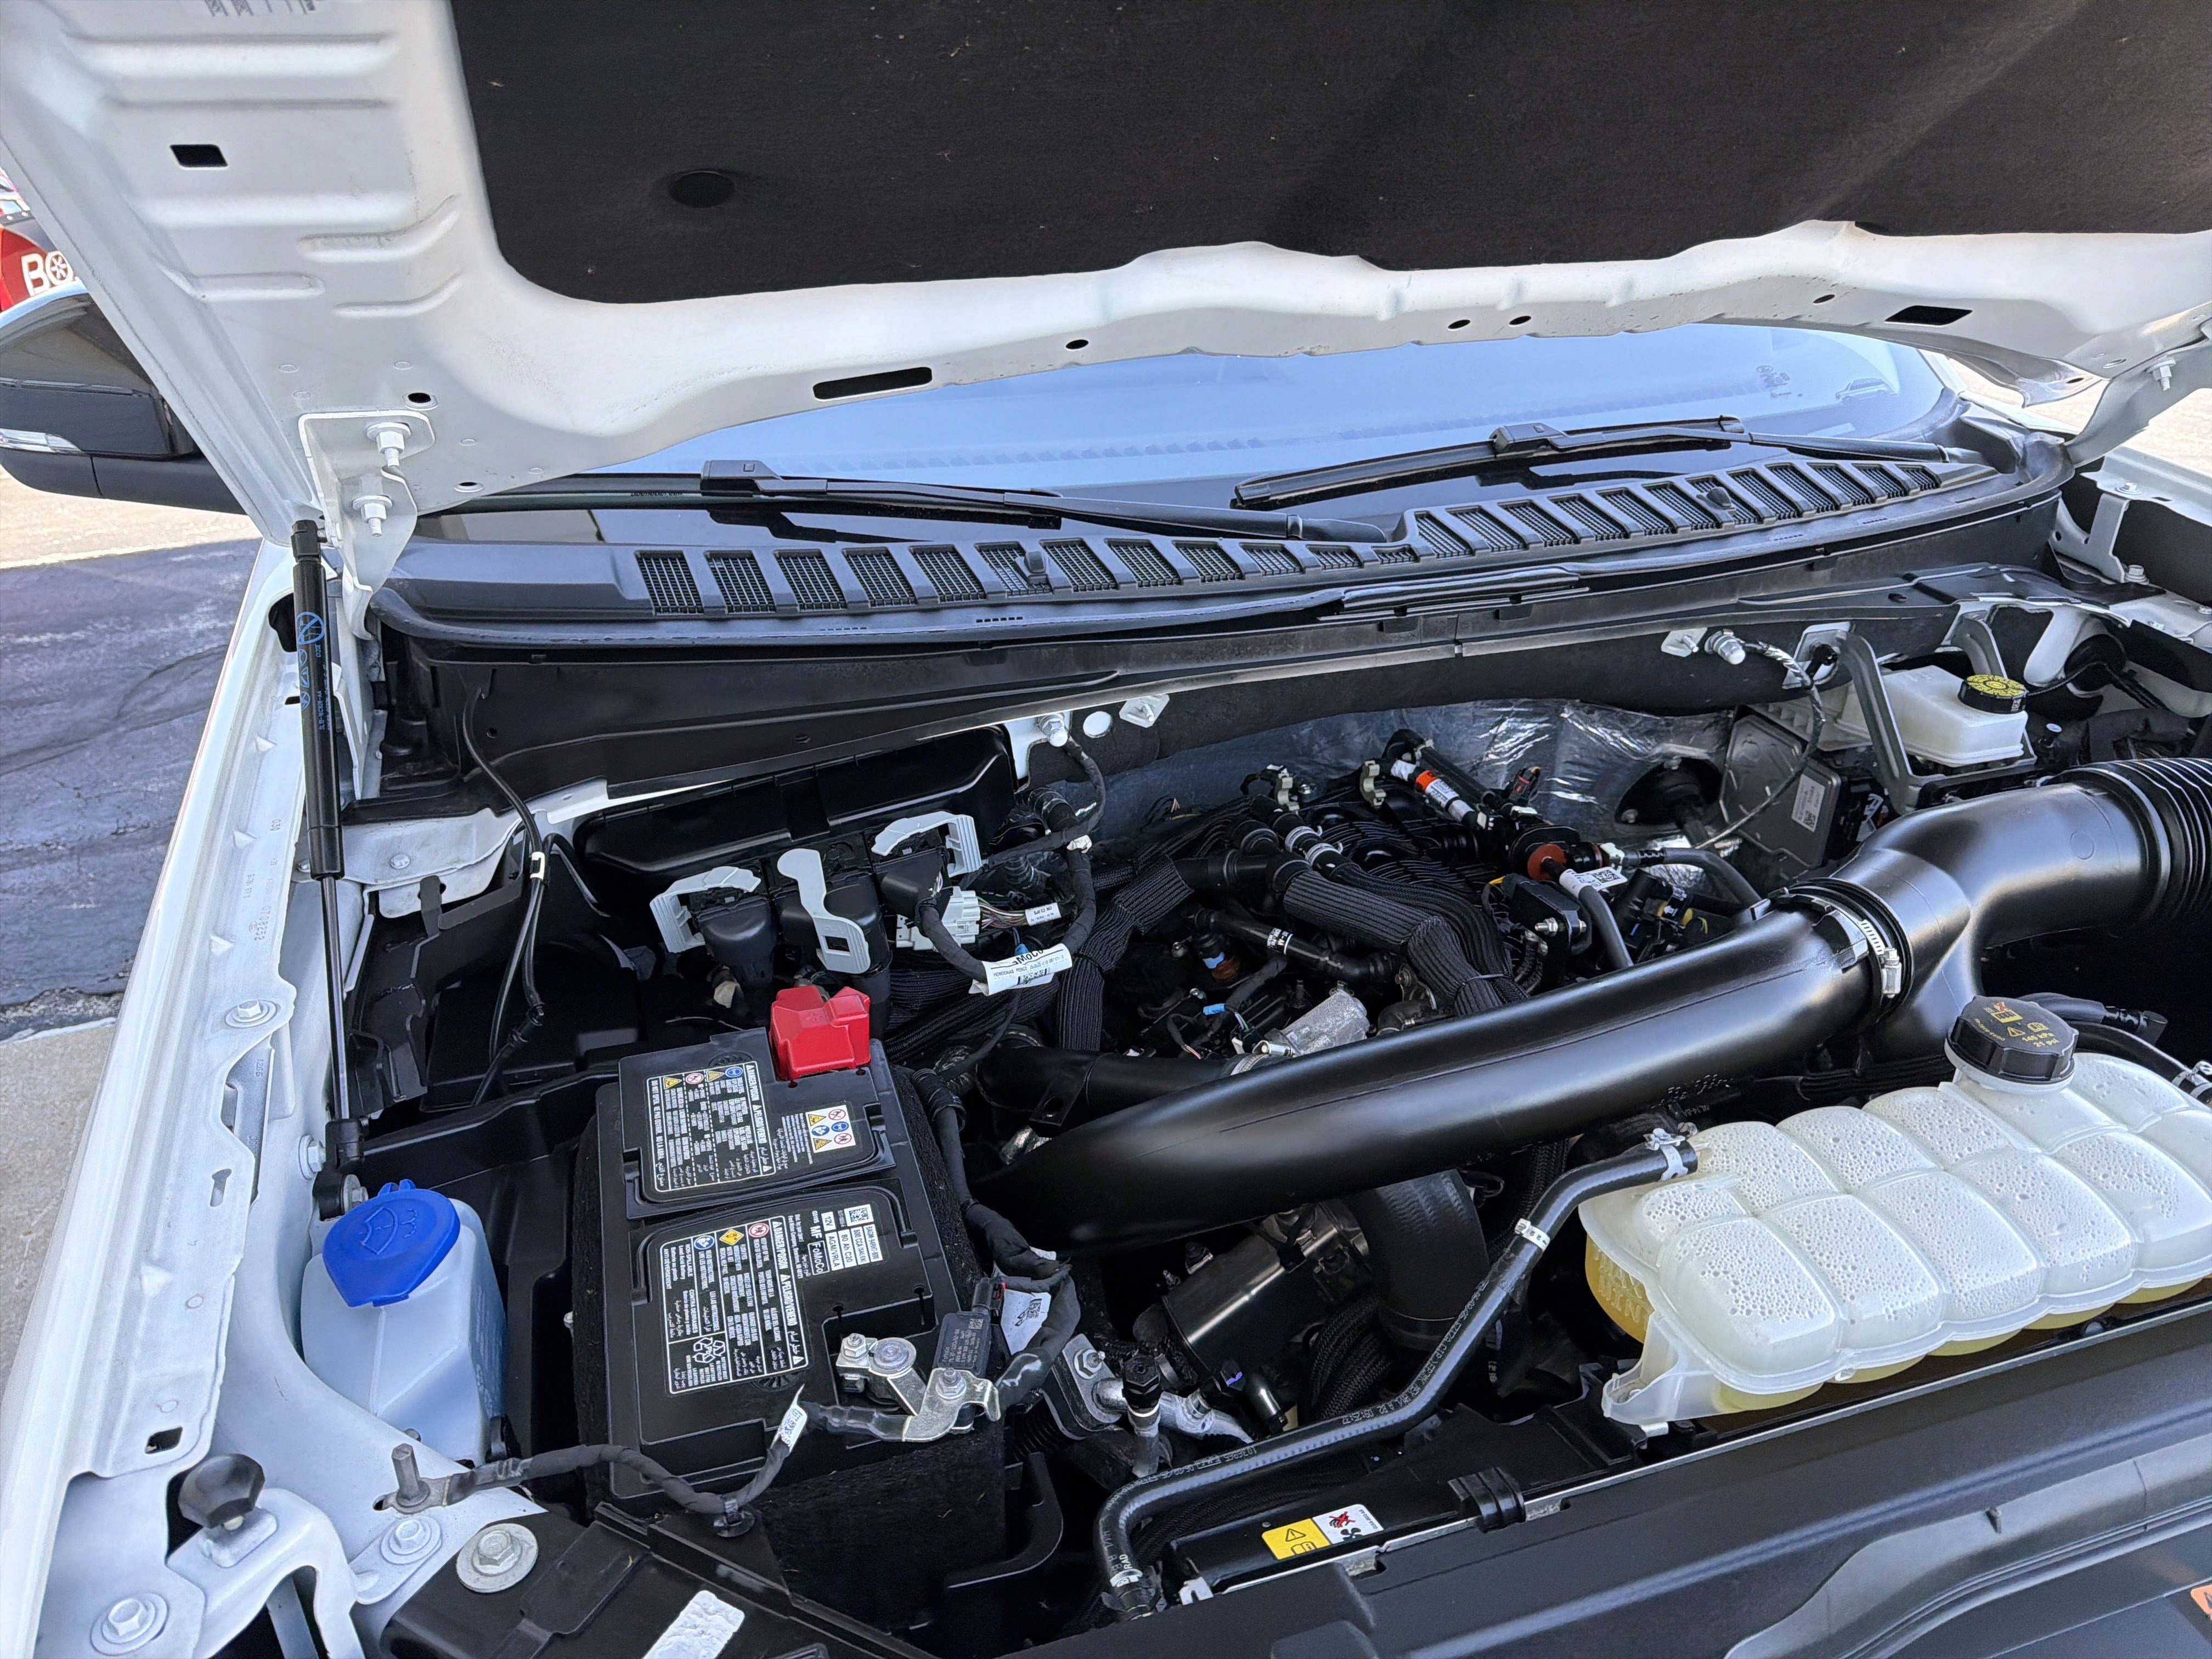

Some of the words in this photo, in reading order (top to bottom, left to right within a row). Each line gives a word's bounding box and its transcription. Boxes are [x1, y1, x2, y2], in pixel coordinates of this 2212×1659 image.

[992, 968, 1014, 978] HONDURAS
[823, 1215, 833, 1227] 12V
[809, 1224, 822, 1240] MF
[840, 1233, 849, 1242] 80
[772, 1226, 789, 1270] DANGER/POISON
[827, 1234, 841, 1267] AGM/VRLA
[842, 1242, 850, 1251] Ah
[684, 1243, 693, 1277] NON-SPILLABLE
[810, 1242, 826, 1273] FoMoCo
[844, 1251, 853, 1263] C20
[679, 1263, 687, 1280] Battery
[780, 1280, 798, 1327] PELIGRO/VENENO
[690, 1307, 698, 1334] DERRAMES
[705, 1345, 713, 1355] Pb
[1124, 1554, 1133, 1570] RAD
